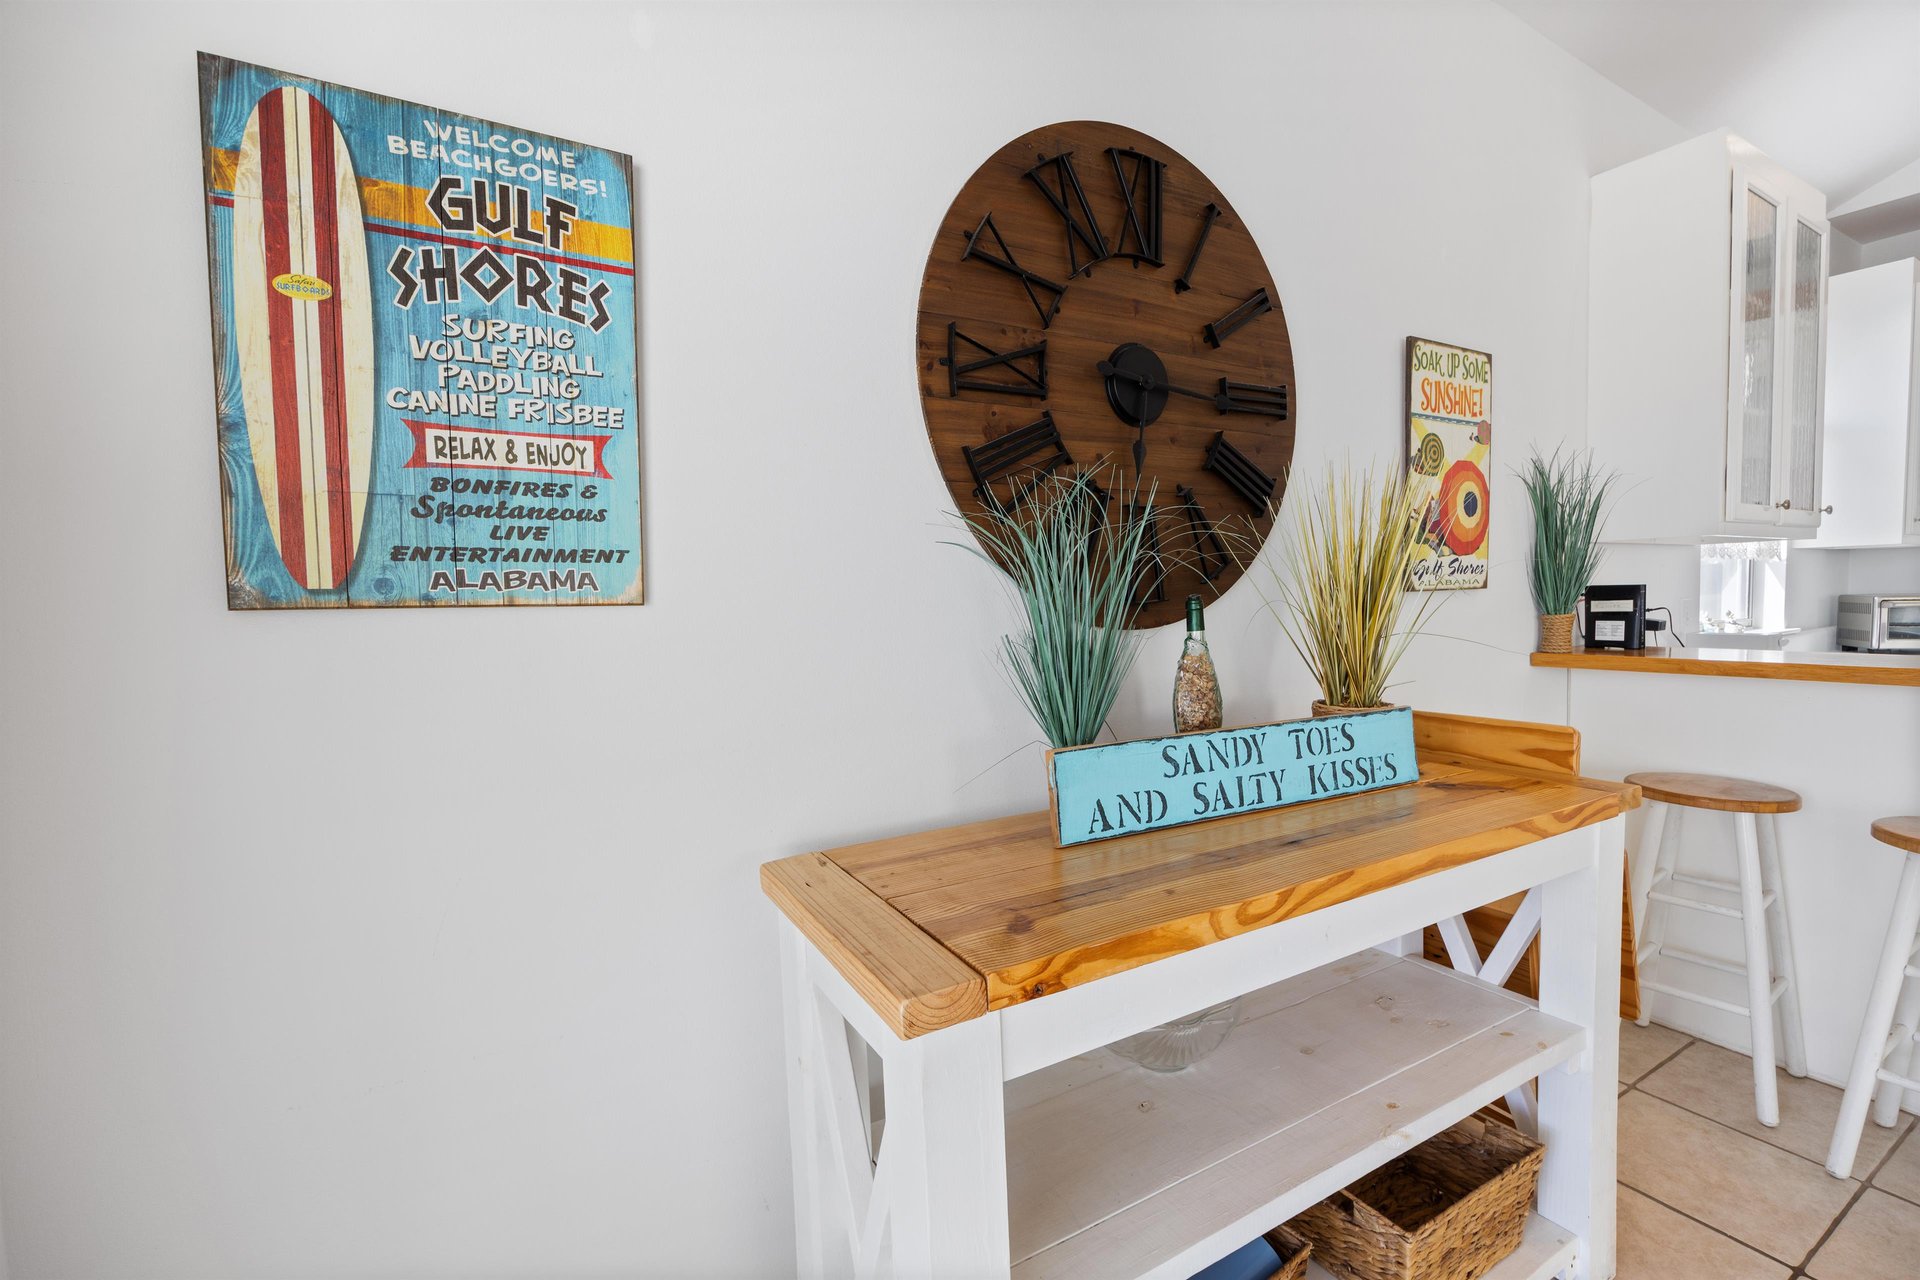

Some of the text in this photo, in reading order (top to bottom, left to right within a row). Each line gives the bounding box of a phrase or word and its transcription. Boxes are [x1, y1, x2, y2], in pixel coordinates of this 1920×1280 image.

[423, 119, 576, 169] WELCOME
[387, 135, 607, 198] BEACHGOERS!
[426, 175, 577, 250] GULF
[387, 246, 612, 333] SHORES
[441, 314, 575, 349] SURFING
[409, 335, 603, 377] VOLLEYBALL
[1413, 344, 1488, 384] SOAK UP SOME
[438, 364, 581, 399] PADDLING
[1420, 377, 1483, 418] SUNSHINE!
[386, 387, 625, 429] CANINE FRISBEE
[433, 435, 588, 469] RELAX & ENJOY
[430, 477, 599, 499] BONFIRES &
[410, 495, 608, 523] Spontaneous
[489, 525, 550, 541] LIVE
[390, 545, 629, 563] ENTERTAINMENT
[1412, 557, 1485, 581] Gulf Shores
[429, 568, 600, 593] ALABAMA
[1161, 722, 1355, 779] SANDY TOES
[1088, 752, 1398, 835] AND SALTY KISSES
